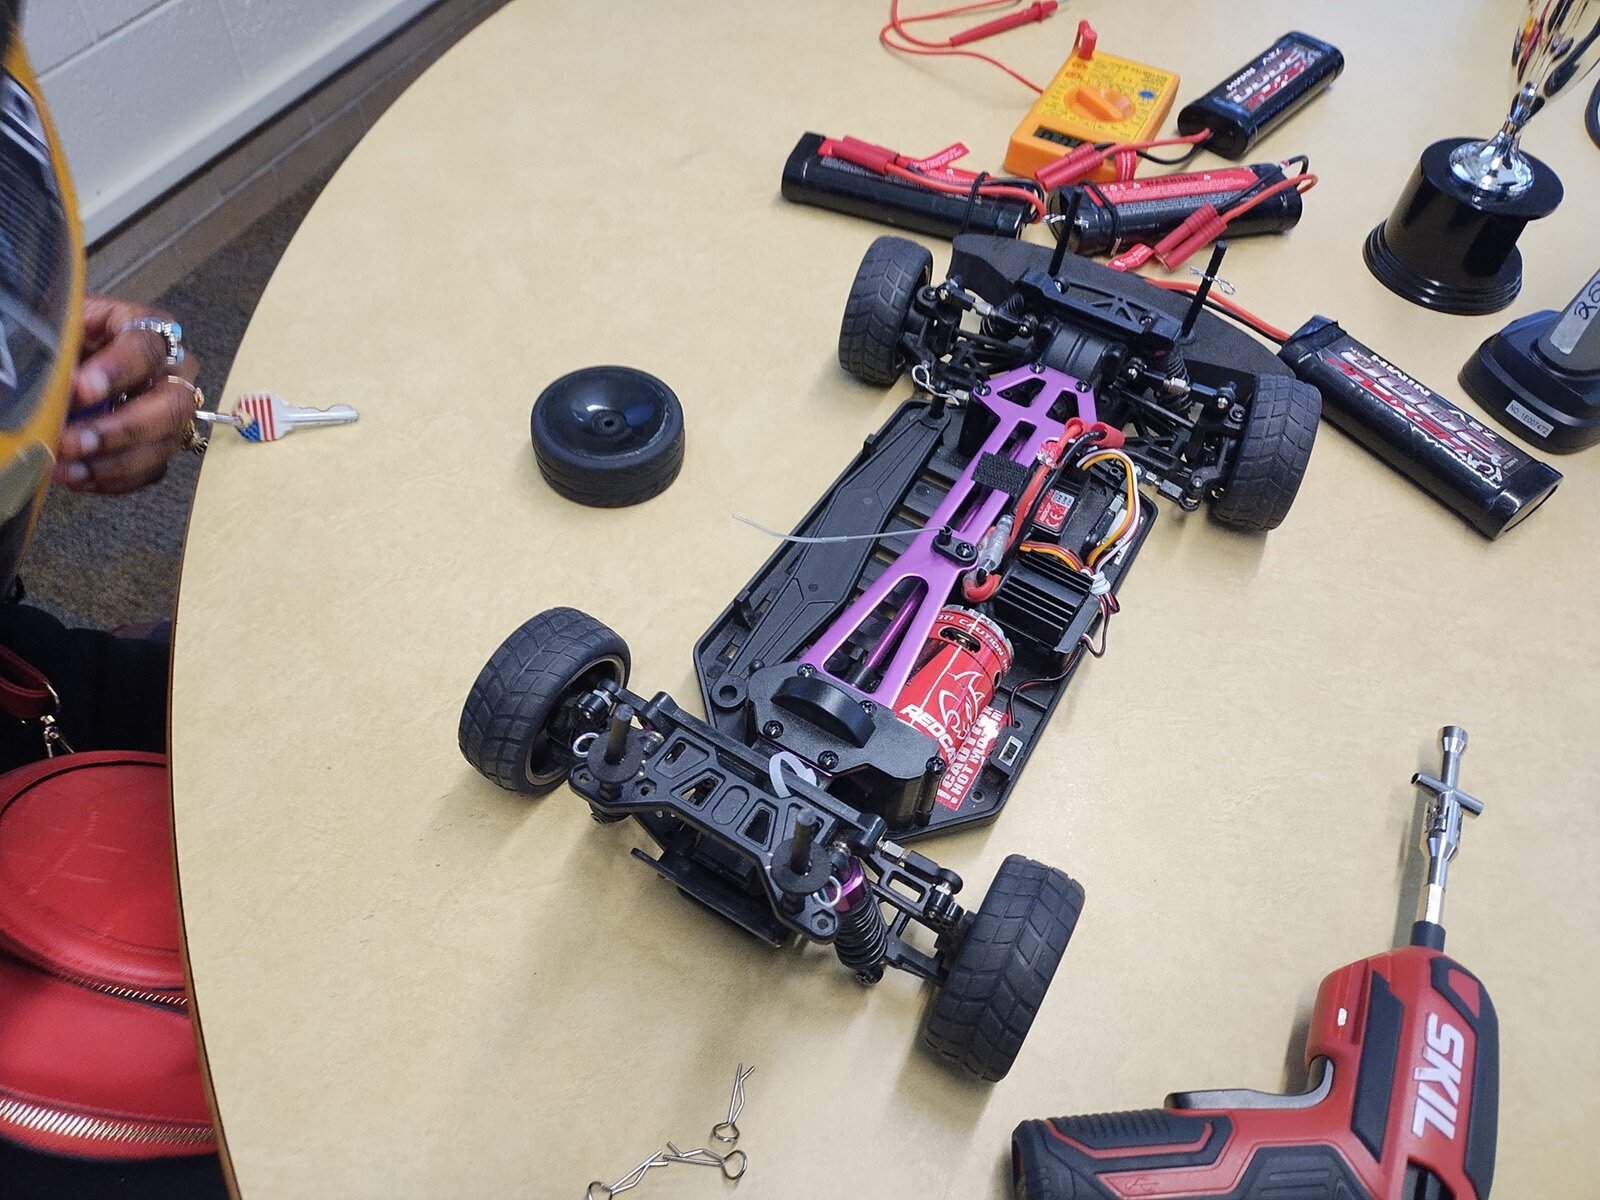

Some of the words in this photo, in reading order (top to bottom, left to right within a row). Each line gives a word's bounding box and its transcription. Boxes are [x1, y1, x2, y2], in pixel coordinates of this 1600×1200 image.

[1341, 351, 1510, 459] 2000
[958, 617, 1004, 656] CAUTION
[899, 703, 958, 764] REDCA
[951, 763, 974, 796] HOT
[1412, 1011, 1465, 1141] SKIL
